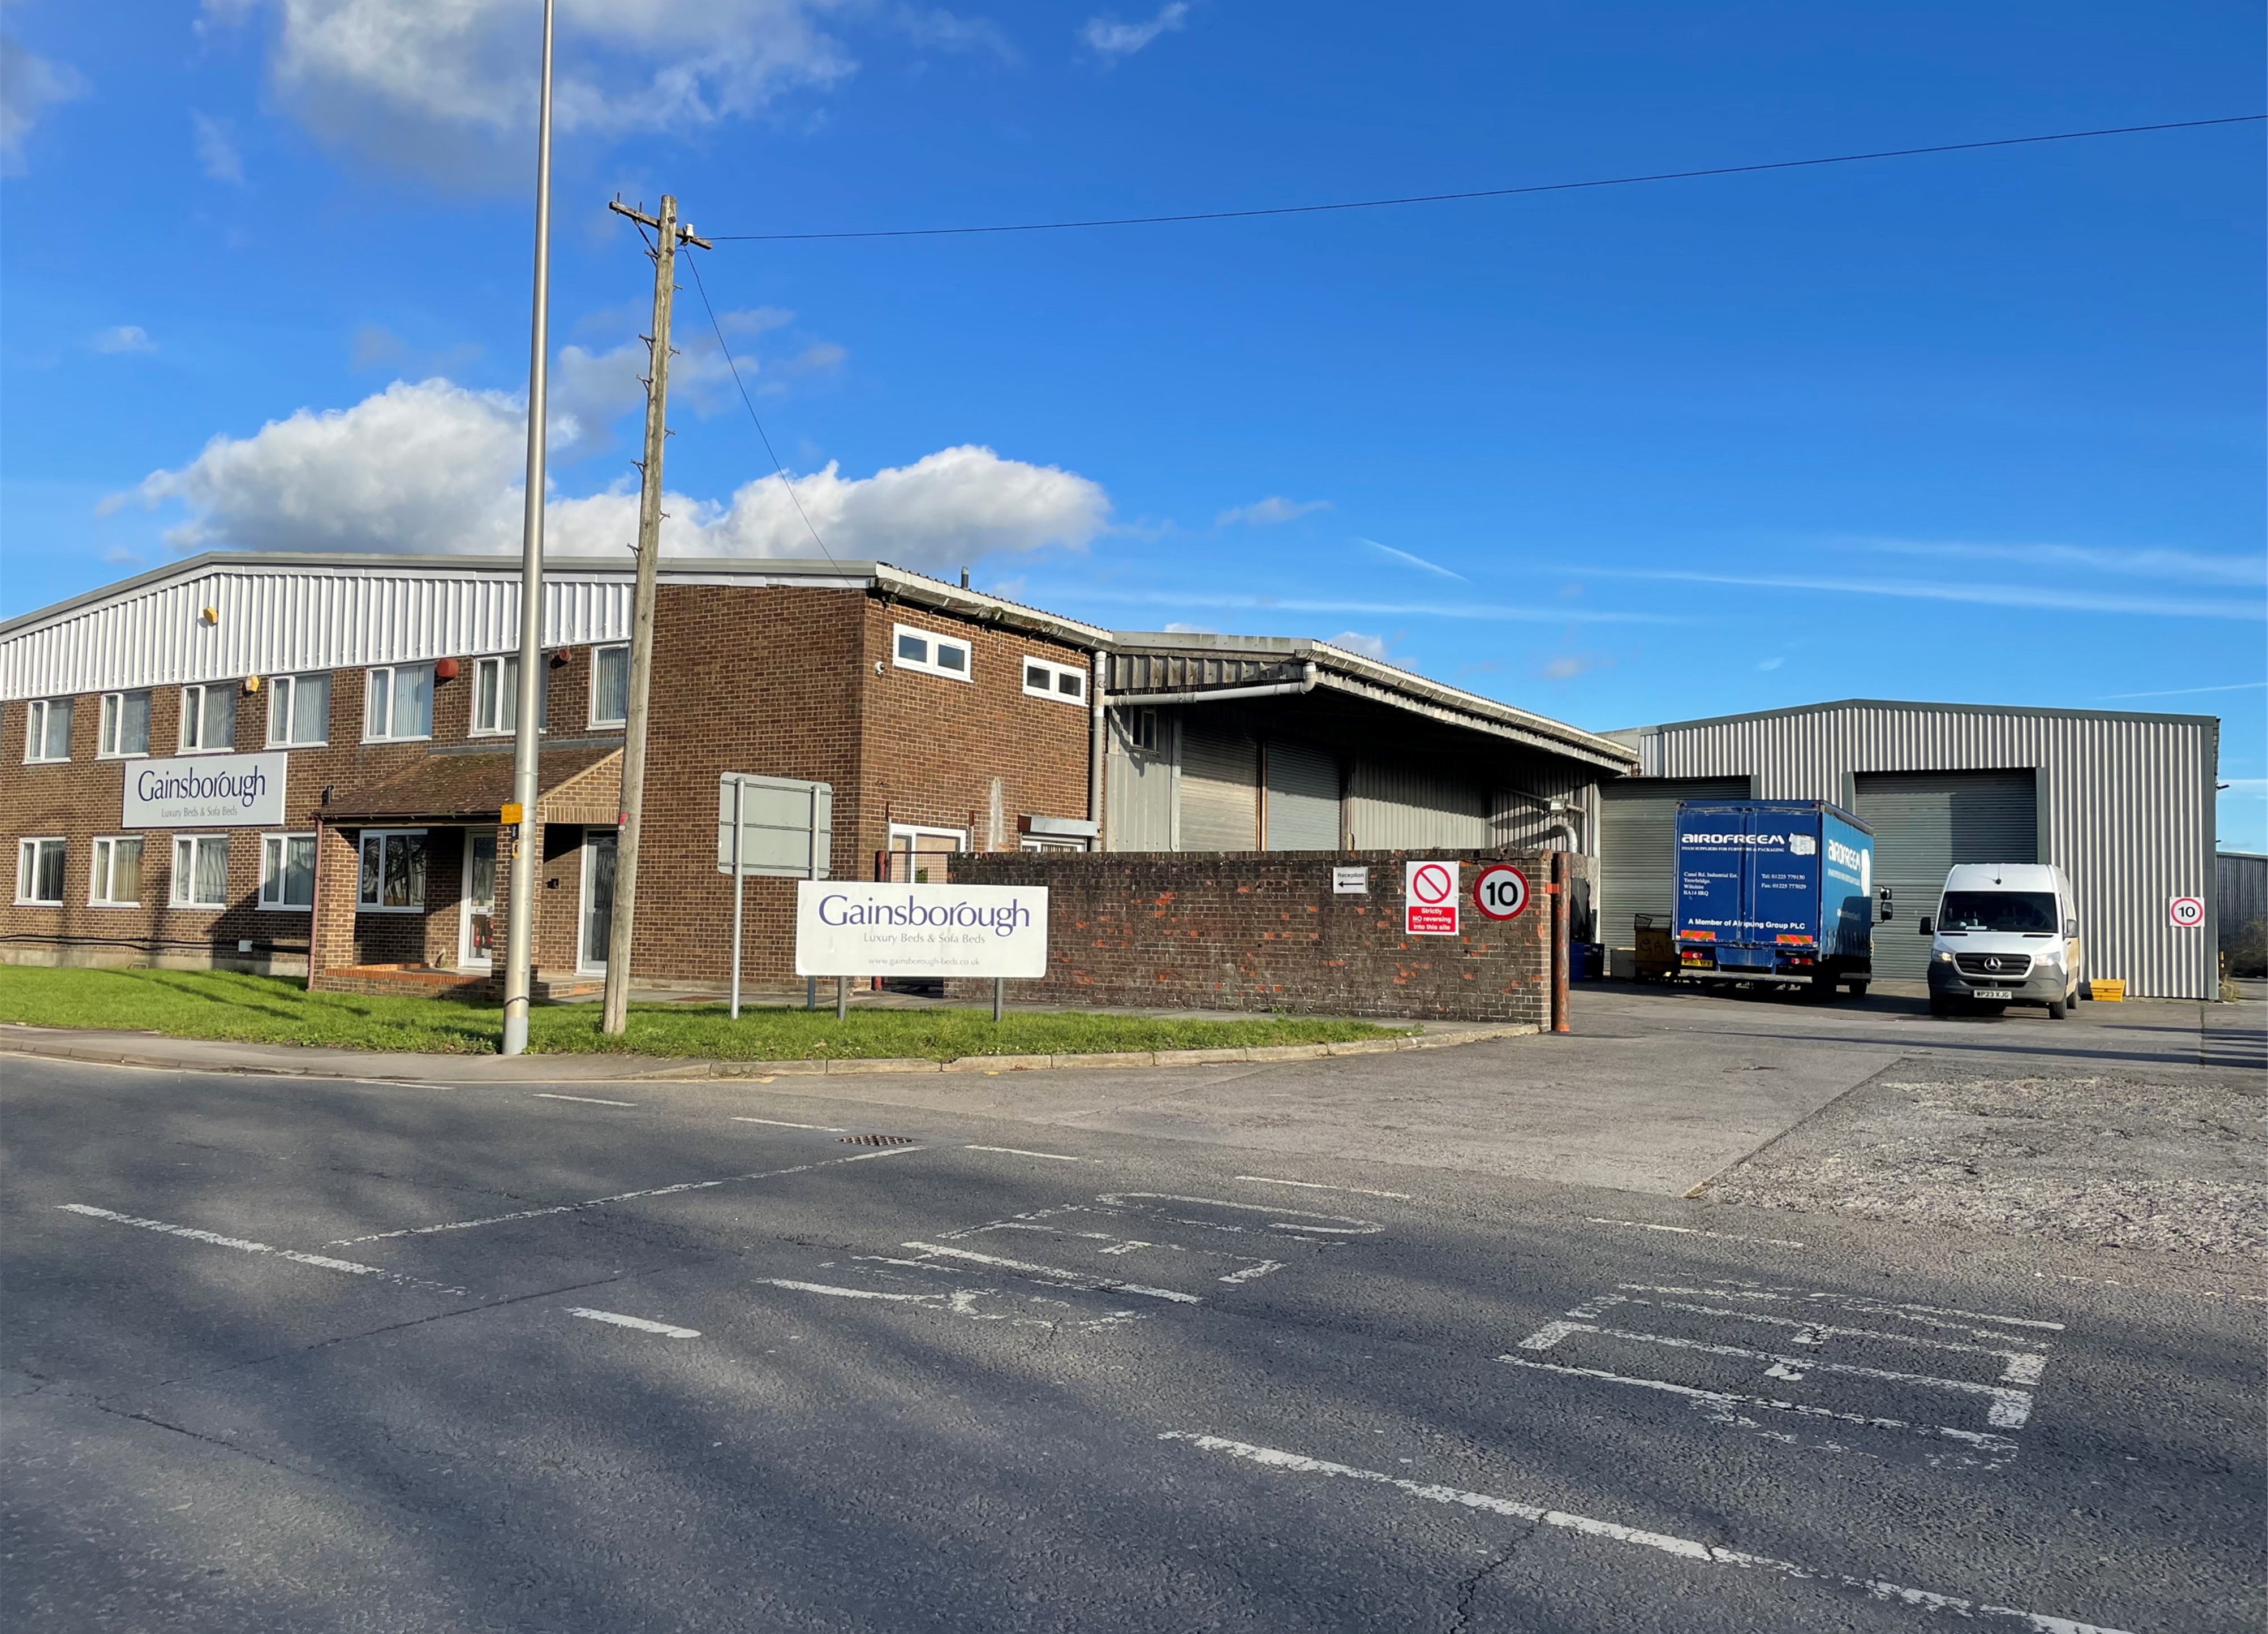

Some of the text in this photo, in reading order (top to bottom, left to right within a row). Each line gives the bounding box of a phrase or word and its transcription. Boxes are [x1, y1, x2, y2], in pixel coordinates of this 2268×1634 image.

[138, 765, 265, 807] Gainsborough
[162, 805, 238, 820] Luxury Beds & Sofa Beds
[1486, 881, 1518, 907] 10
[819, 895, 1030, 937] Gainsborough
[2179, 907, 2196, 917] 10
[1766, 921, 1788, 930] Group
[864, 933, 985, 945] Luxury Beds & Sofa Beds
[868, 957, 980, 967] www.gainsborough-beds.co.uk
